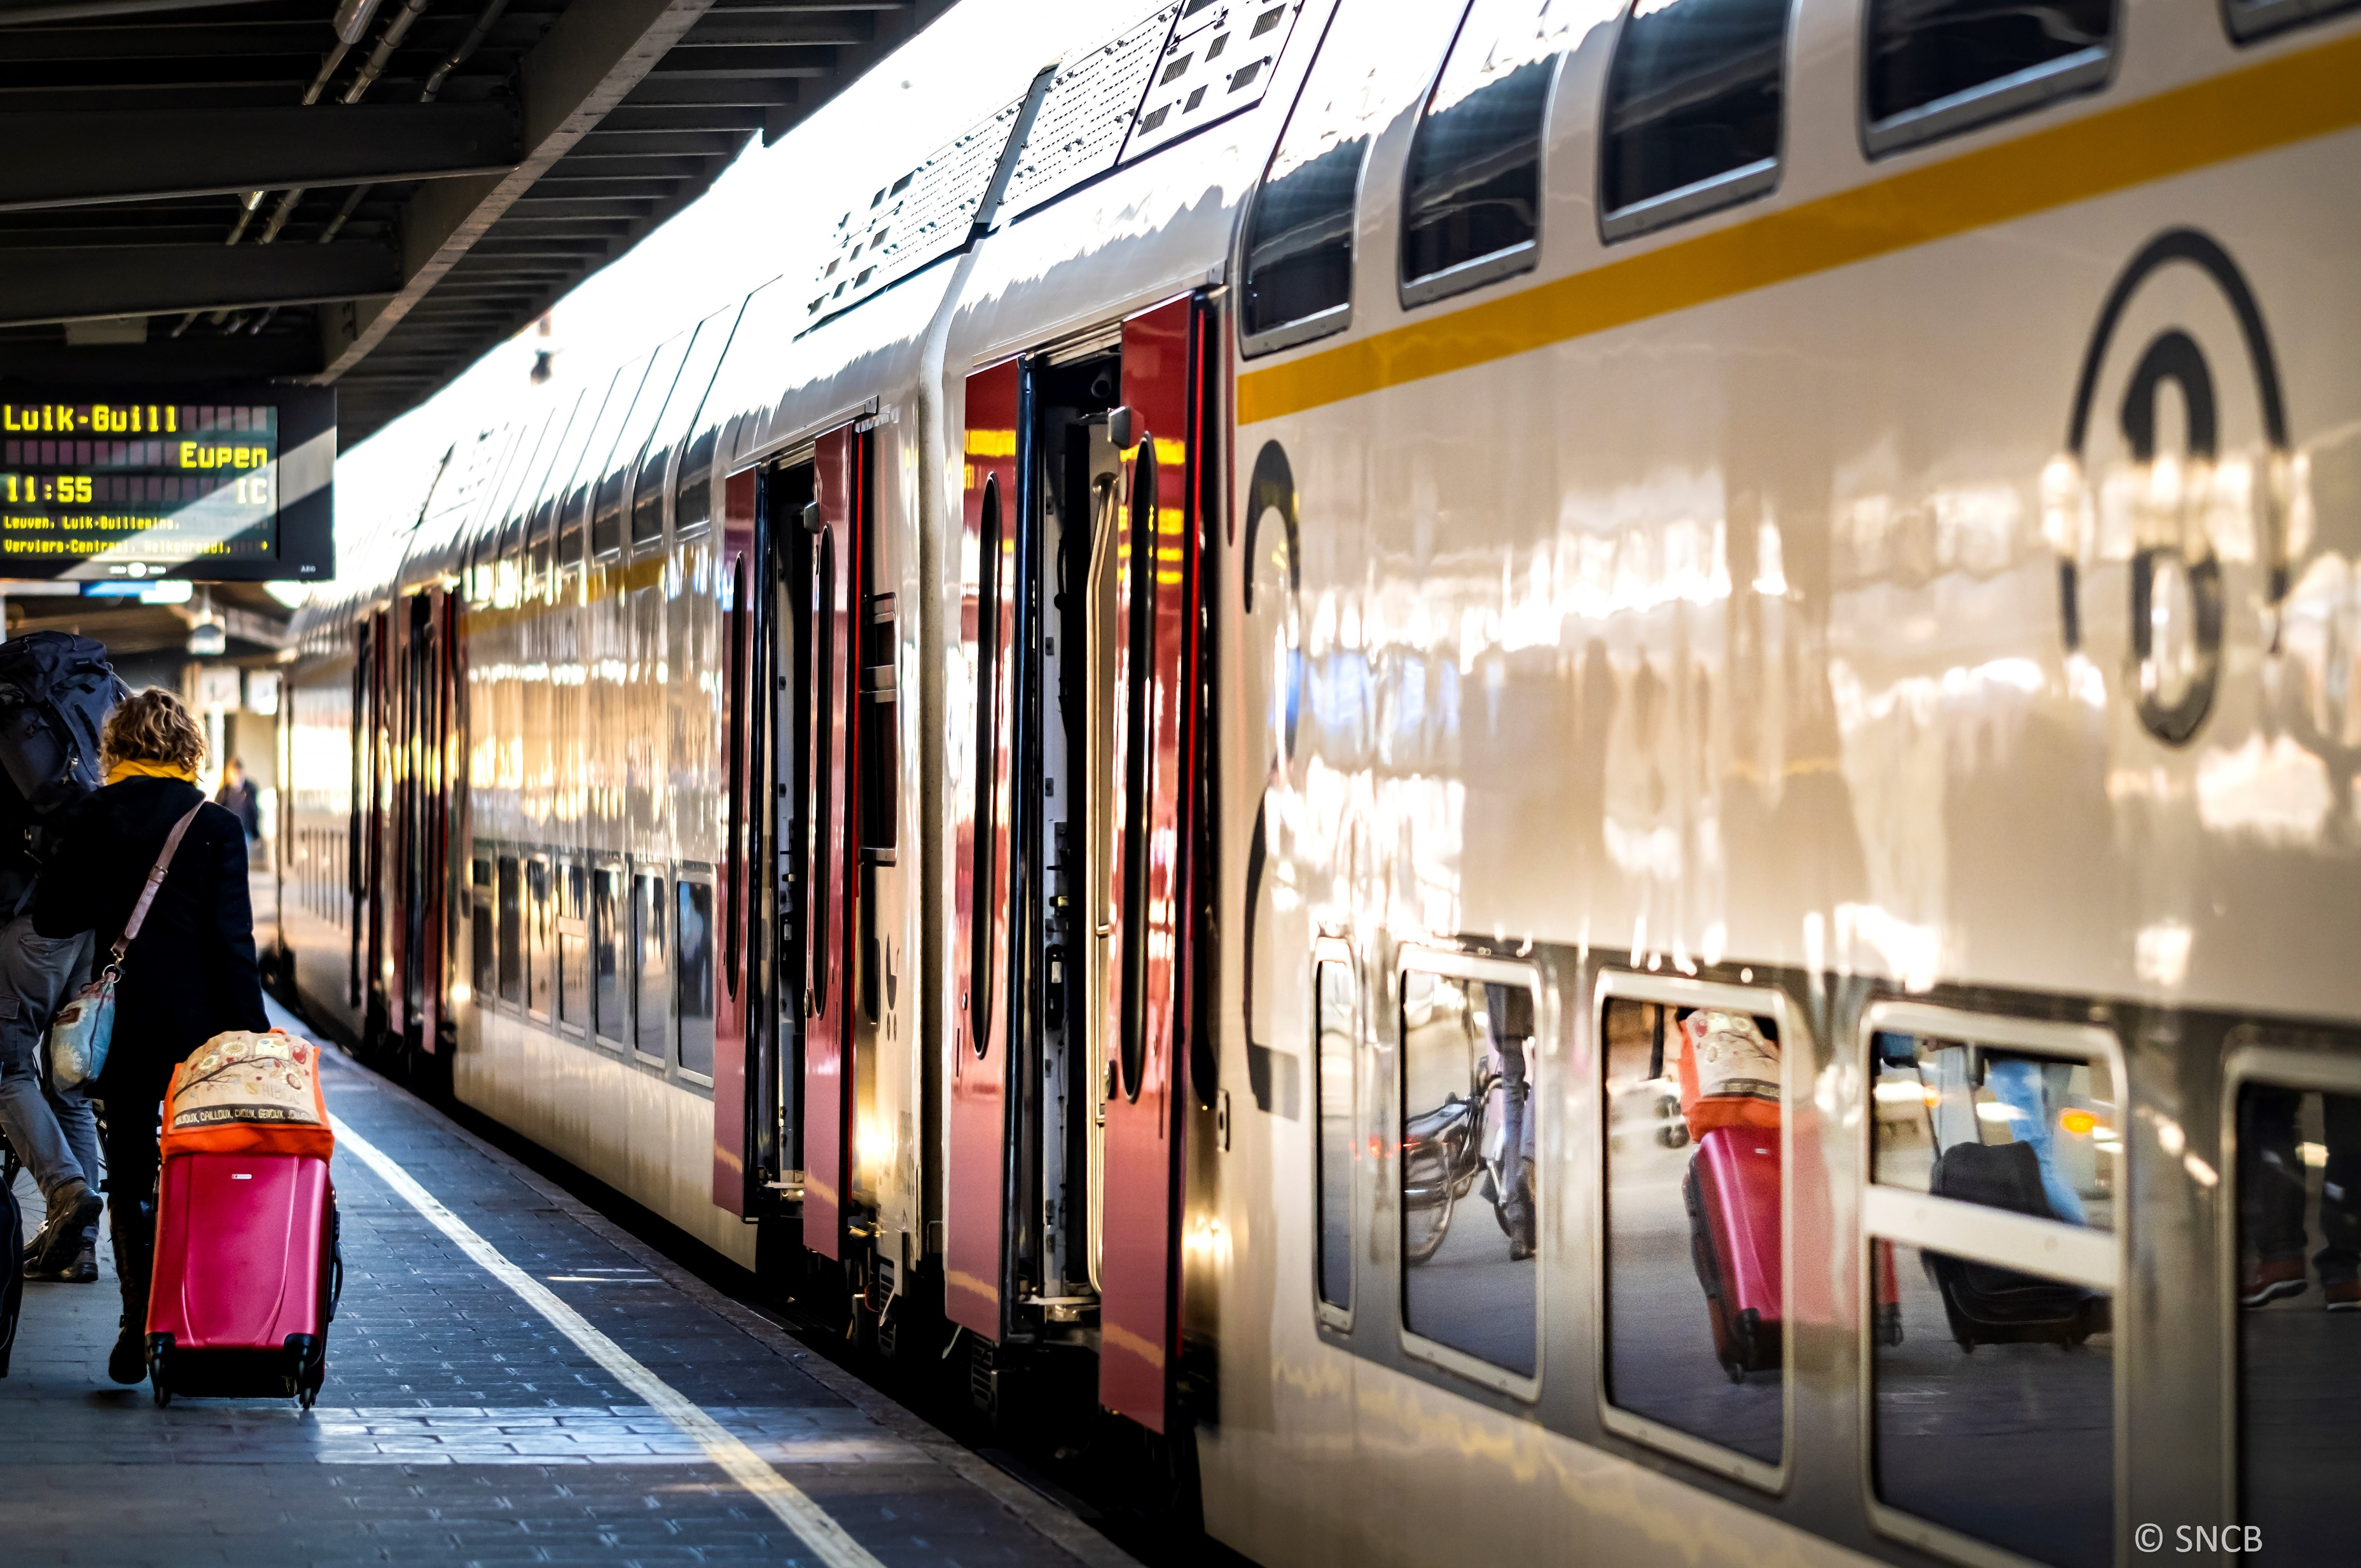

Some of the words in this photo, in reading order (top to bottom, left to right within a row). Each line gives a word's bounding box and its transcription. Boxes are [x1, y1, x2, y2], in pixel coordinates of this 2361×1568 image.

[4, 404, 177, 432] Luik-Guill
[180, 441, 267, 469] Eupen
[8, 476, 92, 503] 11:55
[237, 478, 267, 504] IC
[3, 515, 55, 530] Leuven,
